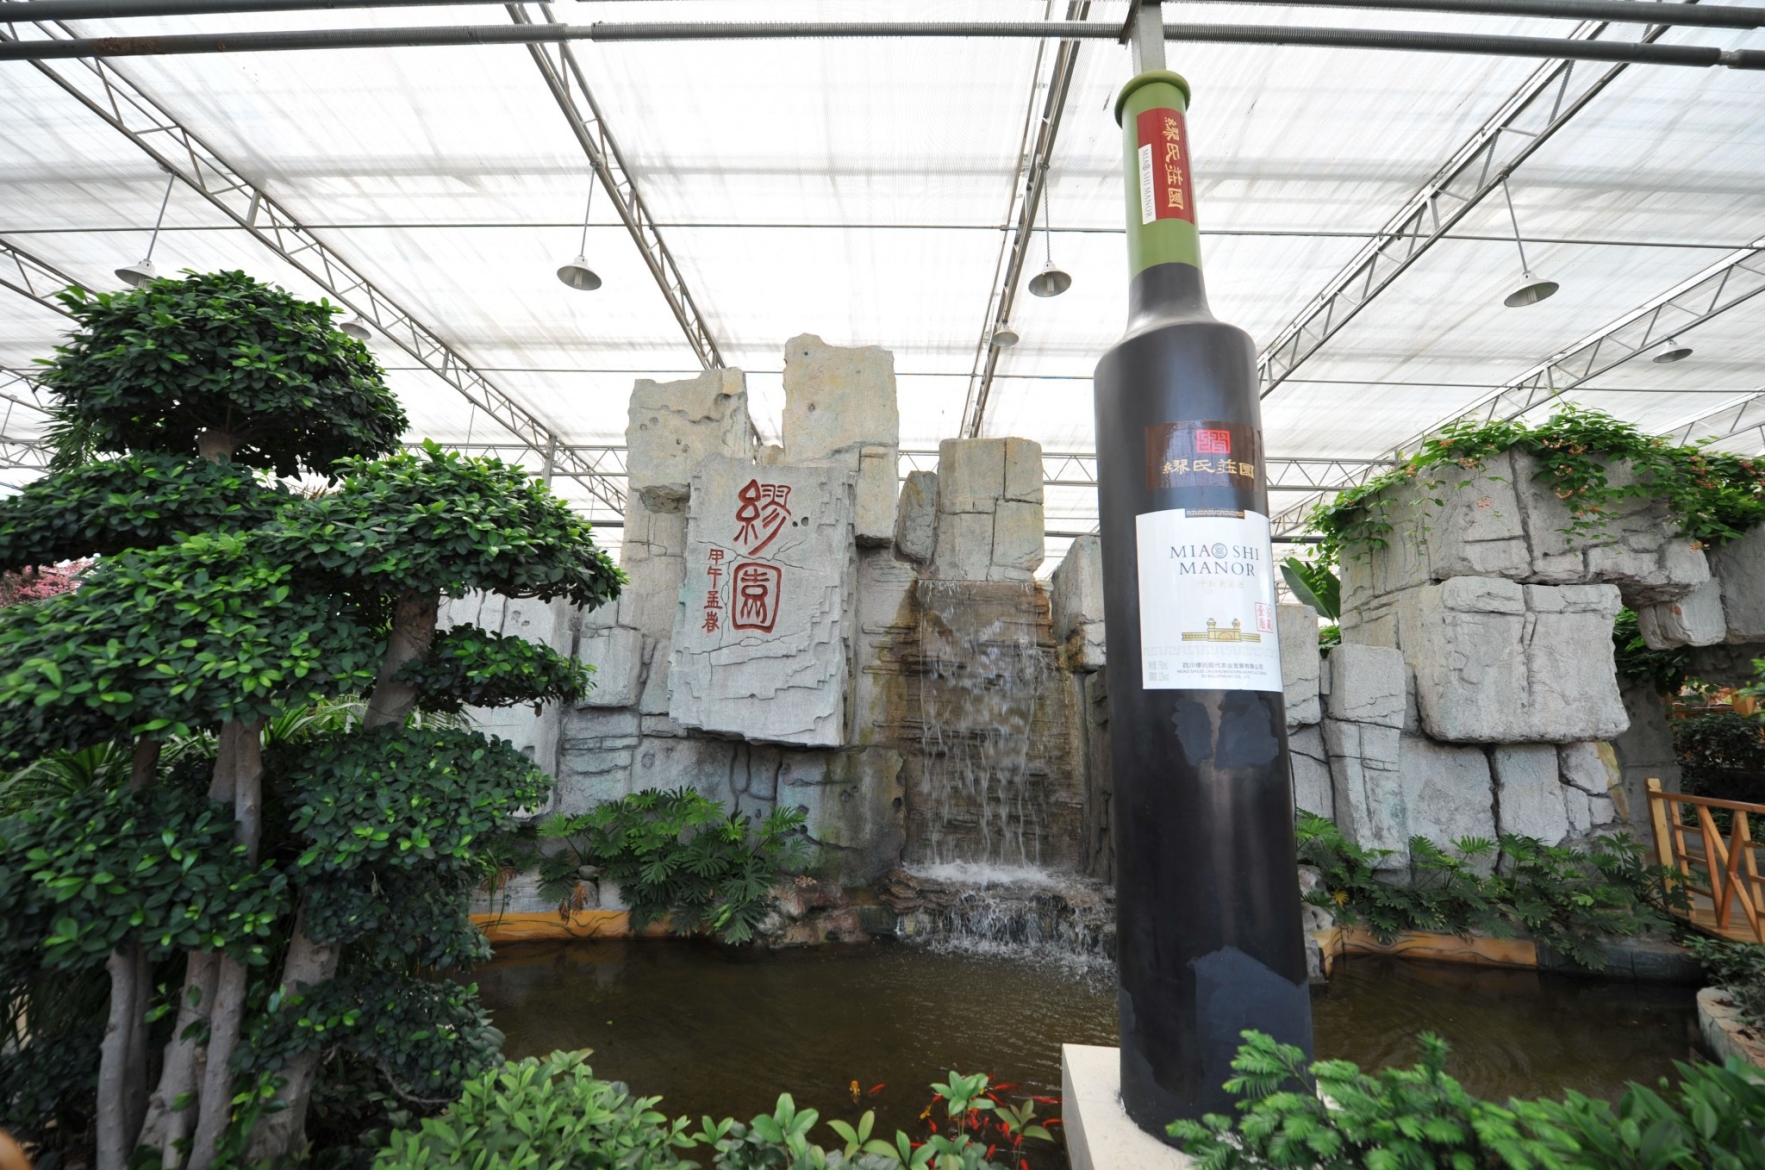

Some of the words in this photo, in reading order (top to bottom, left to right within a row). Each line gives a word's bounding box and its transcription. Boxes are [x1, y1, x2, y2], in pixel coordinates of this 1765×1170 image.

[1143, 171, 1151, 186] SHI
[1144, 187, 1153, 218] MANOR
[1170, 542, 1228, 560] MIAO
[1232, 545, 1259, 561] SHI
[1179, 561, 1256, 577] MANOR
